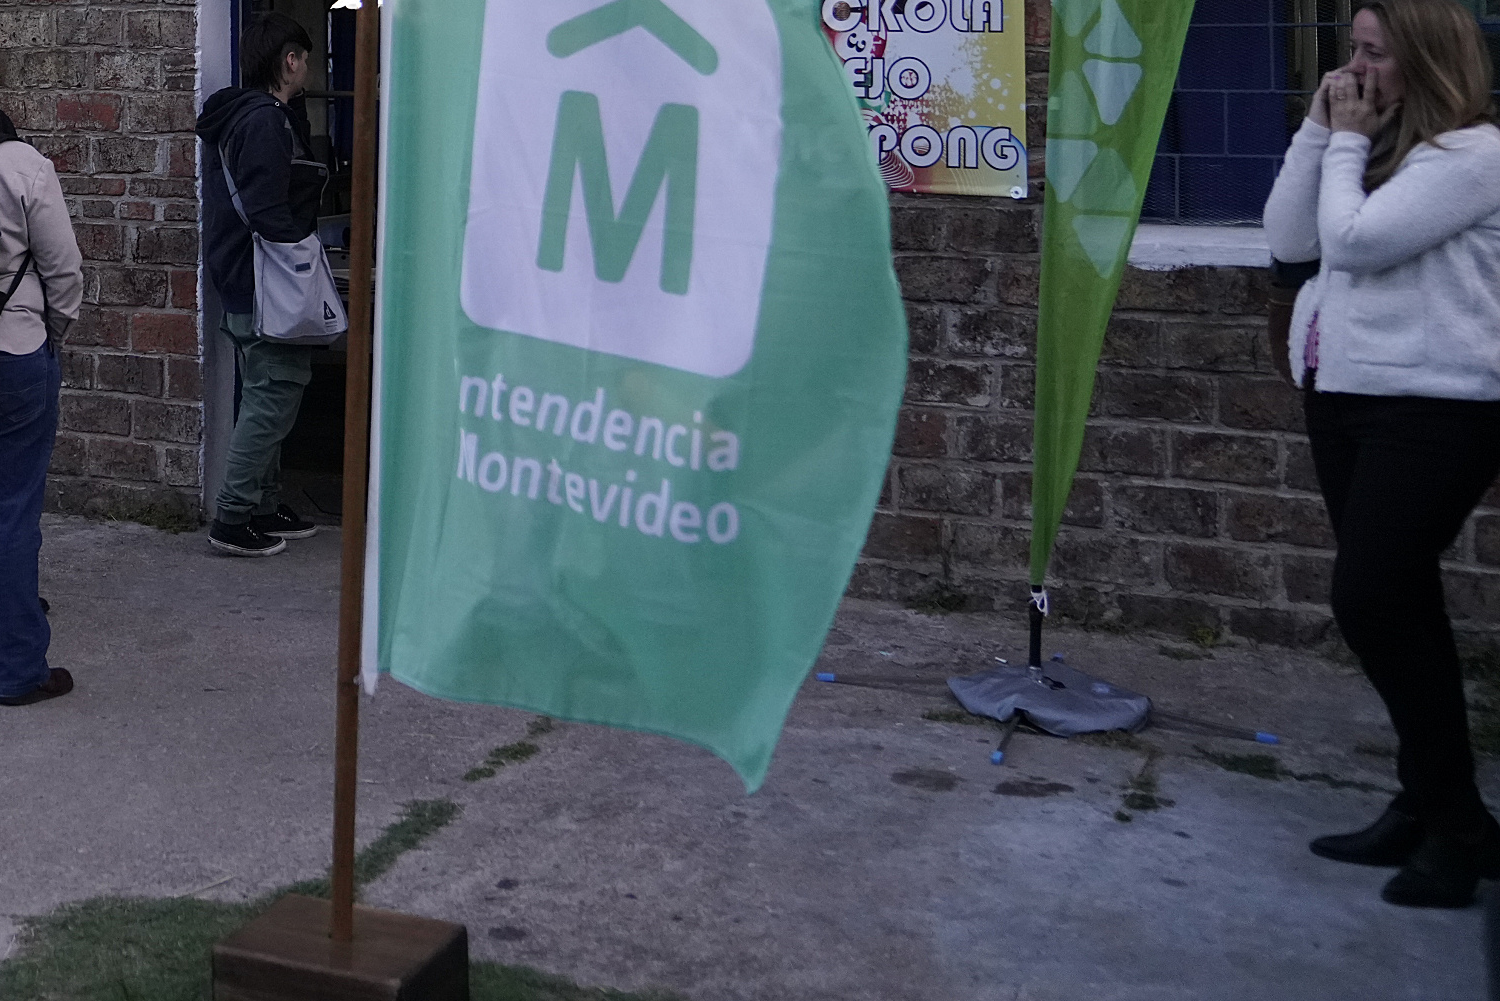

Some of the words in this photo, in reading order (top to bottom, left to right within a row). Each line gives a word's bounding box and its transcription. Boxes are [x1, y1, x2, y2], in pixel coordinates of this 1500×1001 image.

[844, 56, 932, 101] EJO
[868, 123, 1020, 171] PONG
[536, 89, 700, 297] M
